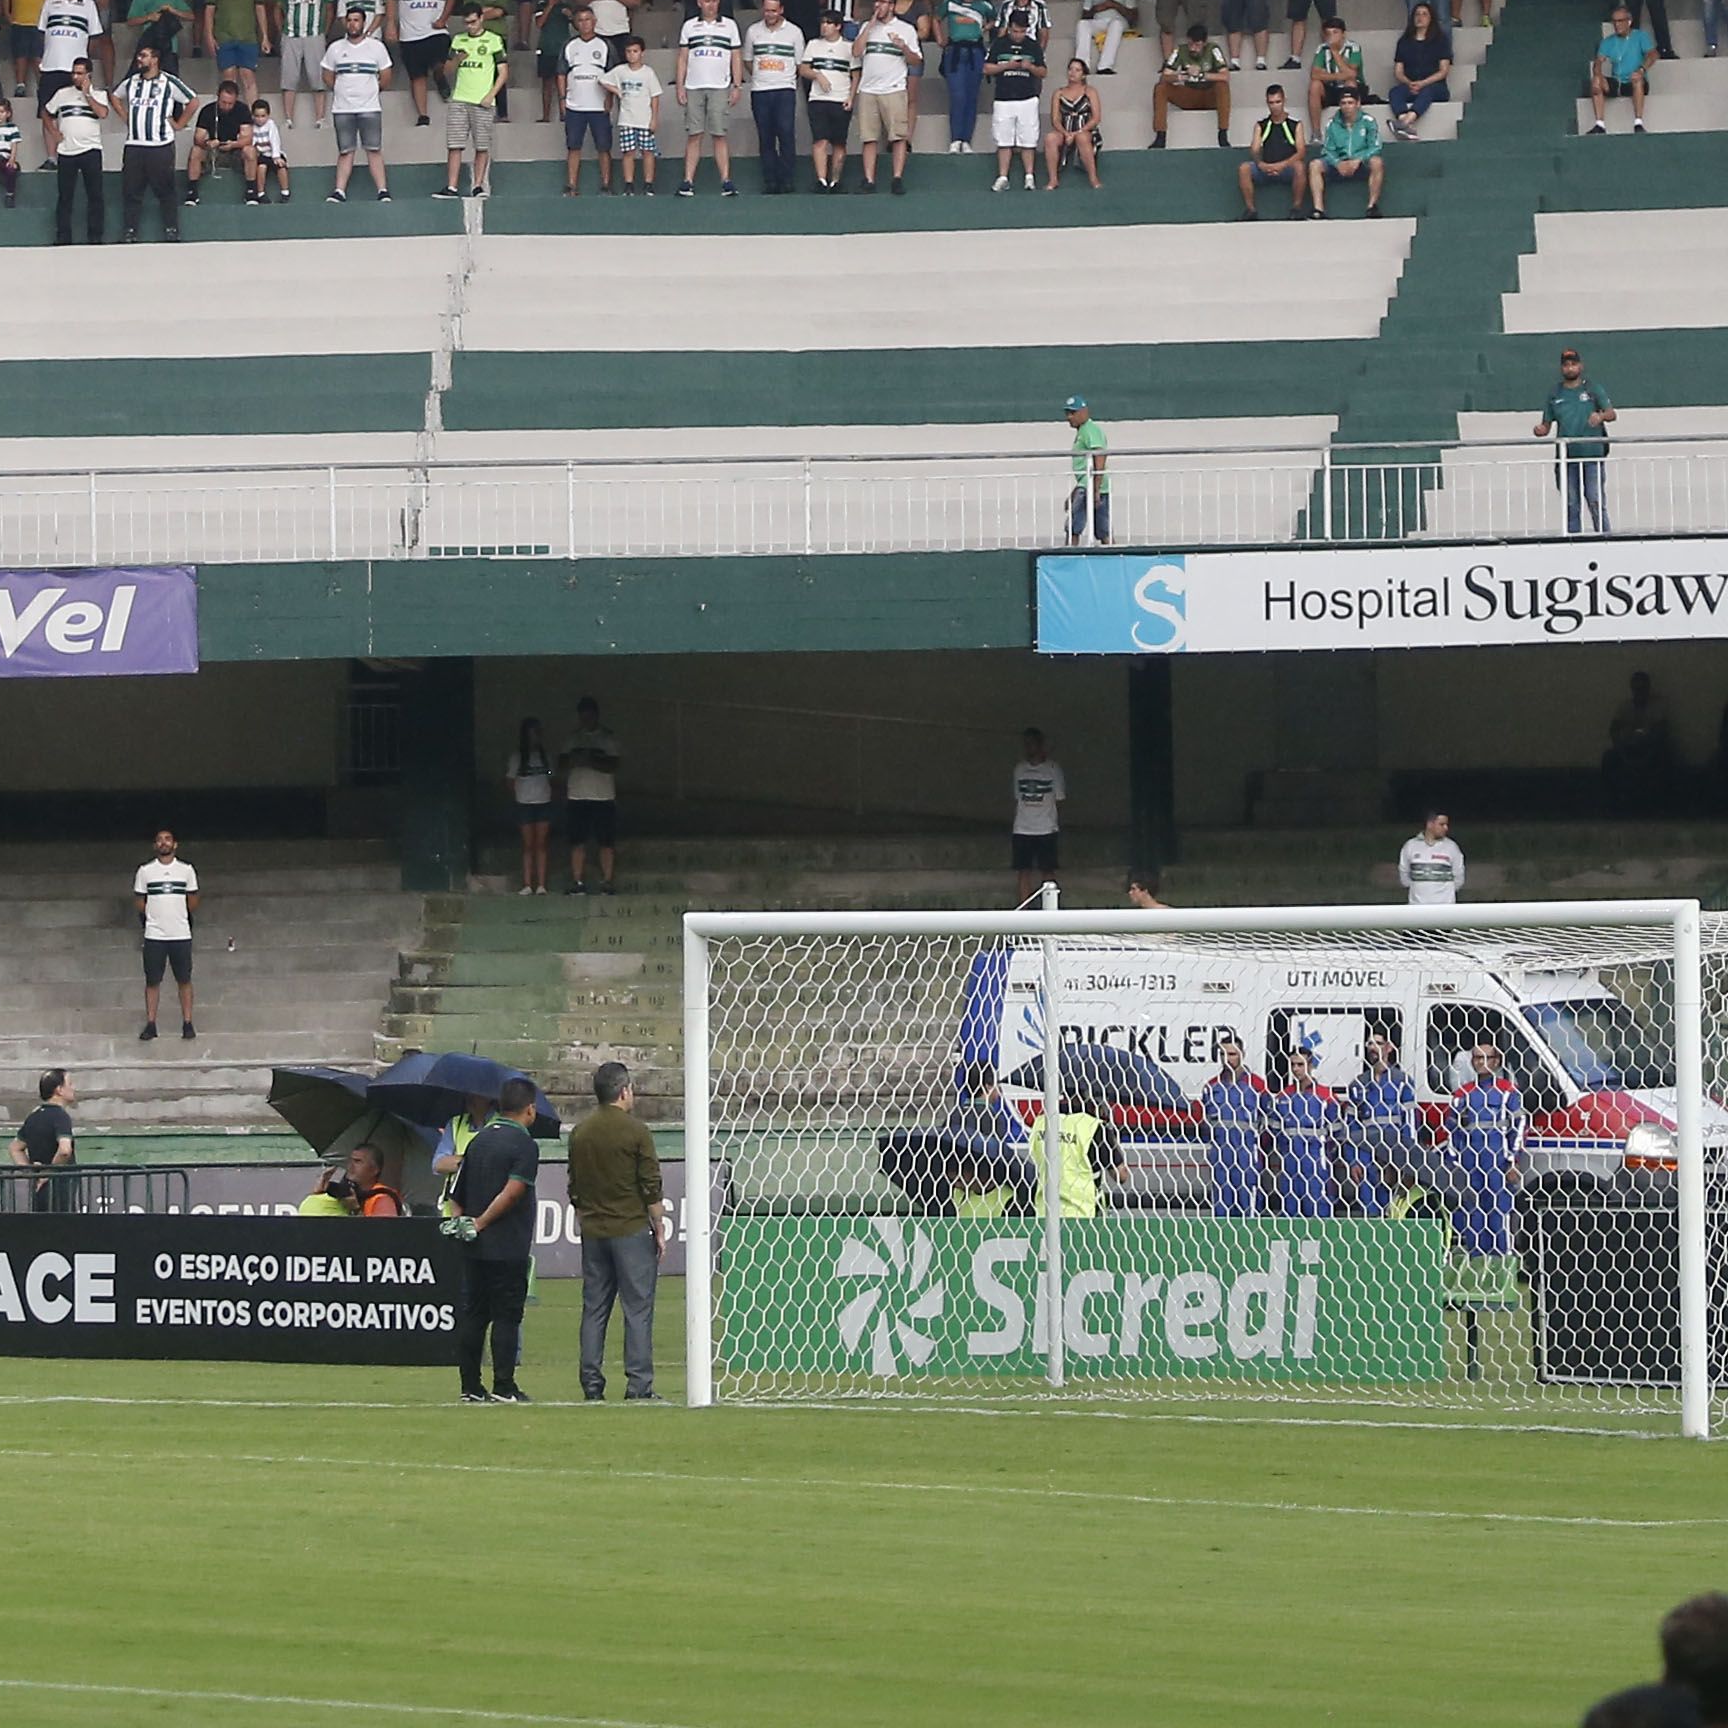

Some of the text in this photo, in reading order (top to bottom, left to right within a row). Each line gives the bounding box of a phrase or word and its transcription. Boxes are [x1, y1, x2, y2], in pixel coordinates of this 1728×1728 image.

[410, 1, 439, 10] CAIXA
[51, 29, 79, 39] CAIXA
[694, 49, 723, 59] CAIXA
[1264, 576, 1450, 629] Hospital
[1086, 975, 1176, 990] 3044-1313
[1287, 970, 1389, 987] UTI MÓVEL
[154, 1254, 435, 1287] O ESPAÇO IDEAL PARA
[967, 1236, 1322, 1359] Sicredi
[135, 1300, 455, 1331] EVENTOS CORPORATIVOS
